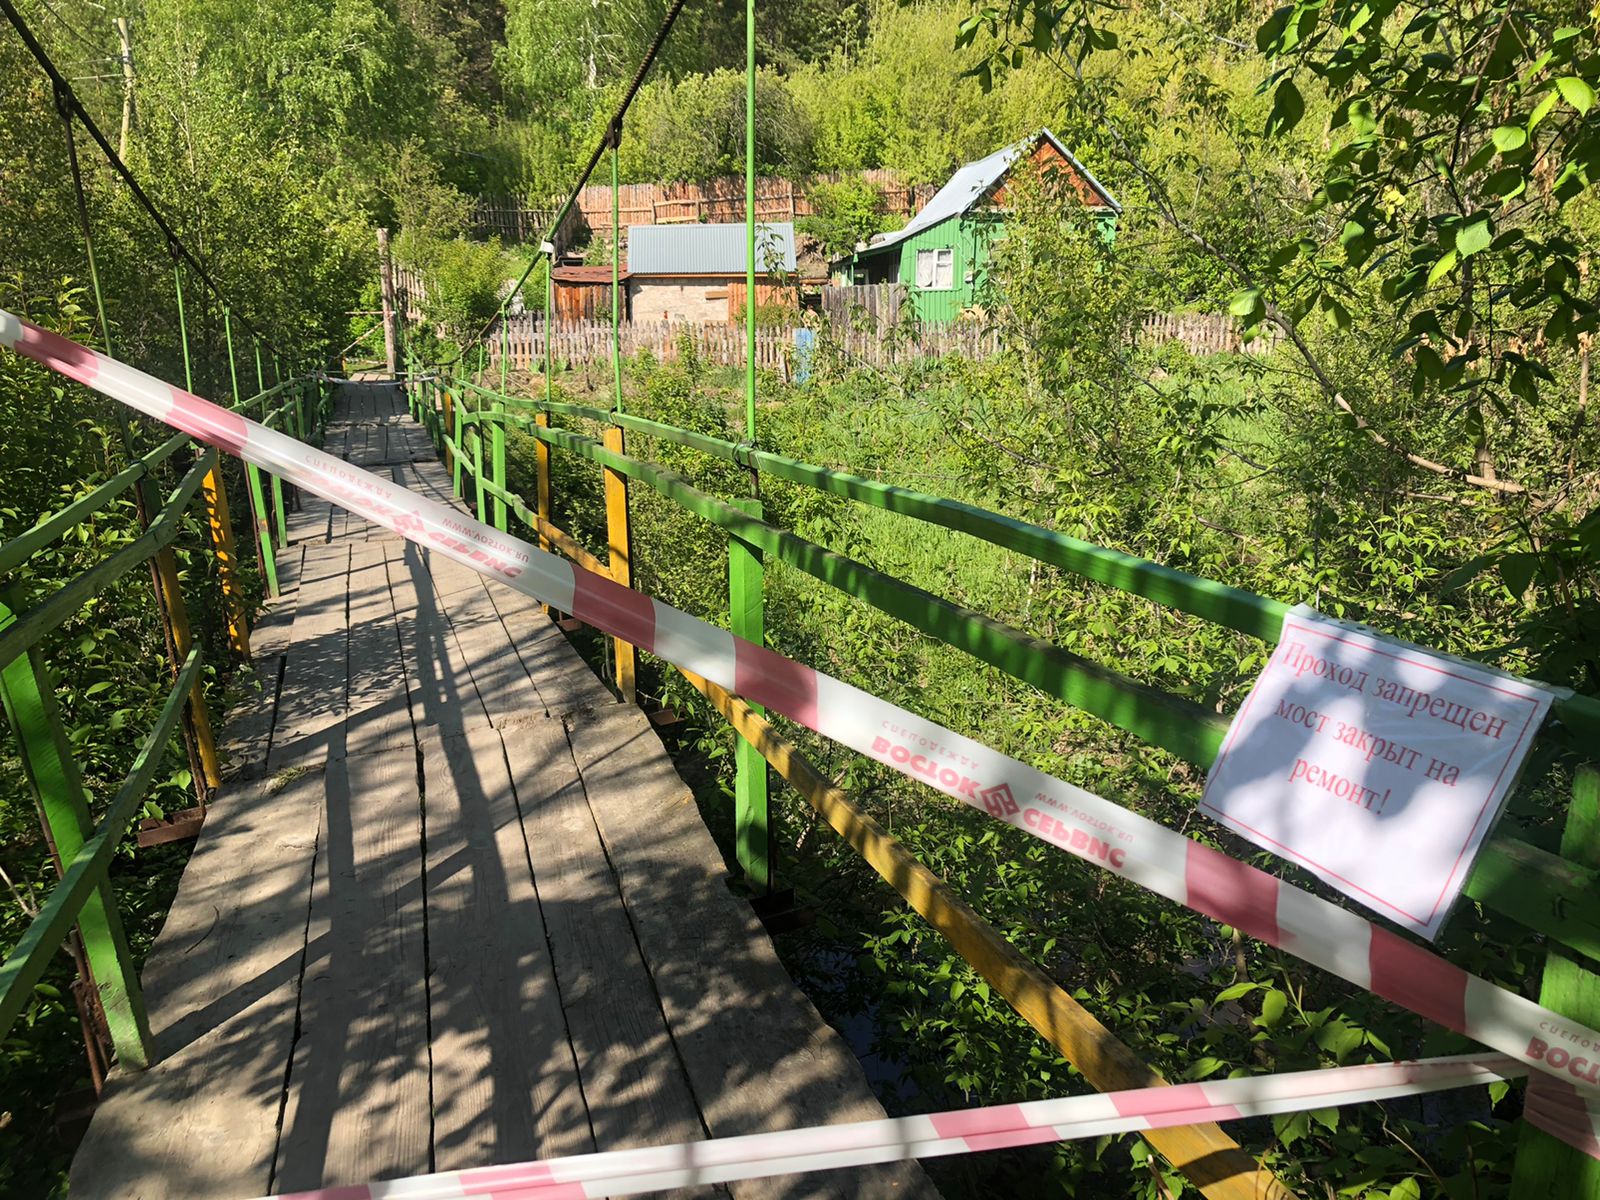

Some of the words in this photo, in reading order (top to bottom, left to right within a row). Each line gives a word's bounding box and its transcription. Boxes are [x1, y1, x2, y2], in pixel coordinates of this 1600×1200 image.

[1282, 642, 1367, 692] Проход
[1371, 676, 1509, 741] запрещен
[1274, 698, 1330, 733] мост
[1333, 720, 1422, 771] закрыт
[1424, 756, 1461, 788] на
[1288, 757, 1392, 815] ремонт!
